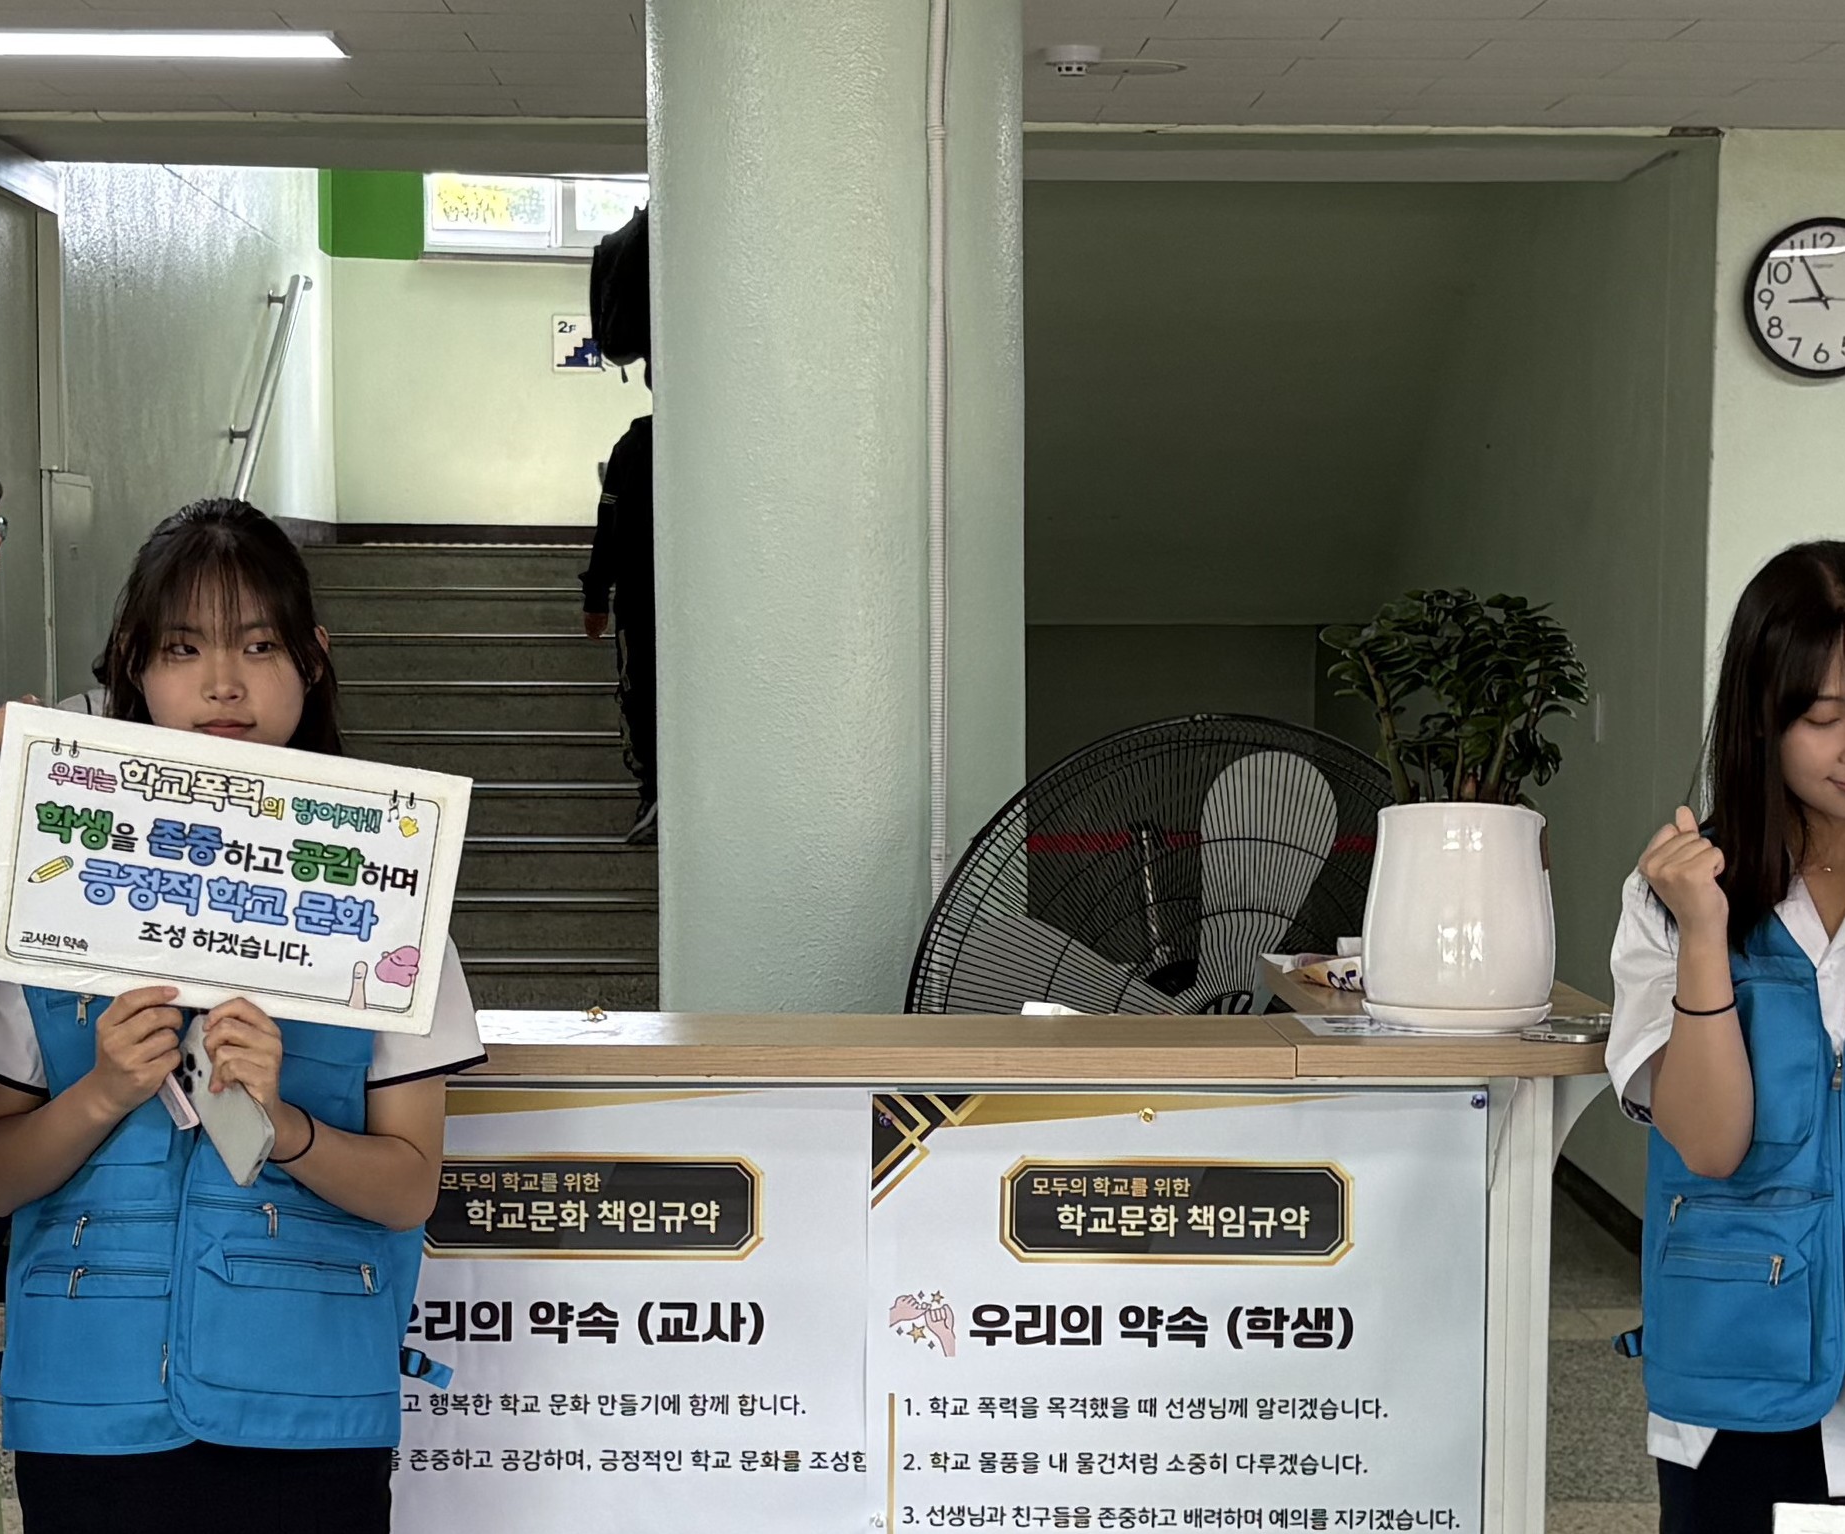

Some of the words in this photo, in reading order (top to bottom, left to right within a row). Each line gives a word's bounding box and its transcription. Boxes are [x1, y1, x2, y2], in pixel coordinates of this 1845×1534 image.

[1768, 261, 1792, 285] 10
[1758, 288, 1775, 310] 9
[1767, 316, 1783, 339] 8
[1787, 337, 1802, 358] 7
[1813, 343, 1830, 364] 6
[48, 761, 118, 794] 우리는
[120, 758, 285, 821] 학교폭력의
[292, 797, 384, 834] 방어자!!
[35, 801, 140, 853] 학생을
[147, 818, 285, 877] 존중하고
[287, 838, 419, 897] 공감하며
[79, 856, 202, 917] 긍정적
[207, 874, 288, 926] 학교
[293, 890, 379, 942] 문화
[19, 930, 61, 949] 교사의
[138, 921, 187, 950] 조성
[193, 927, 314, 969] 하겠습니다.
[440, 1173, 497, 1193] 모두의
[502, 1173, 559, 1193] 학교를
[563, 1173, 601, 1193] 위한
[1031, 1176, 1089, 1198] 모두의
[1092, 1176, 1149, 1198] 학교를
[1154, 1177, 1191, 1198] 위한
[466, 1199, 588, 1234] 학교문화
[597, 1199, 720, 1235] 책임규약
[1056, 1204, 1179, 1239] 학교문화
[1187, 1205, 1310, 1240] 책임규약
[529, 1301, 620, 1344] 약속
[637, 1300, 765, 1346] (교사)
[968, 1304, 1102, 1348] 우리의
[1119, 1305, 1209, 1349] 약속
[1226, 1304, 1355, 1351] (학생)
[430, 1393, 493, 1416] 행복한
[499, 1394, 541, 1415] 학교
[549, 1394, 590, 1416] 문화
[597, 1393, 681, 1416] 만들기에
[688, 1393, 729, 1416] 함께
[738, 1393, 807, 1416] 합니다.
[904, 1397, 921, 1416] 1.
[929, 1397, 970, 1419] 학교
[977, 1397, 1039, 1419] 폭력을
[1047, 1397, 1130, 1419] 목격했을
[1138, 1397, 1157, 1419] 때
[1165, 1397, 1248, 1420] 선생님께
[1256, 1398, 1388, 1420] 알리겠습니다.
[903, 1506, 920, 1524] 3.
[926, 1506, 1006, 1528] 선생님과
[1012, 1506, 1092, 1529] 친구들을
[1097, 1507, 1177, 1529] 존중하고
[1184, 1508, 1262, 1530] 배려하며
[1269, 1508, 1329, 1531] 예의를
[1334, 1508, 1460, 1531] 지키겠습니다.
